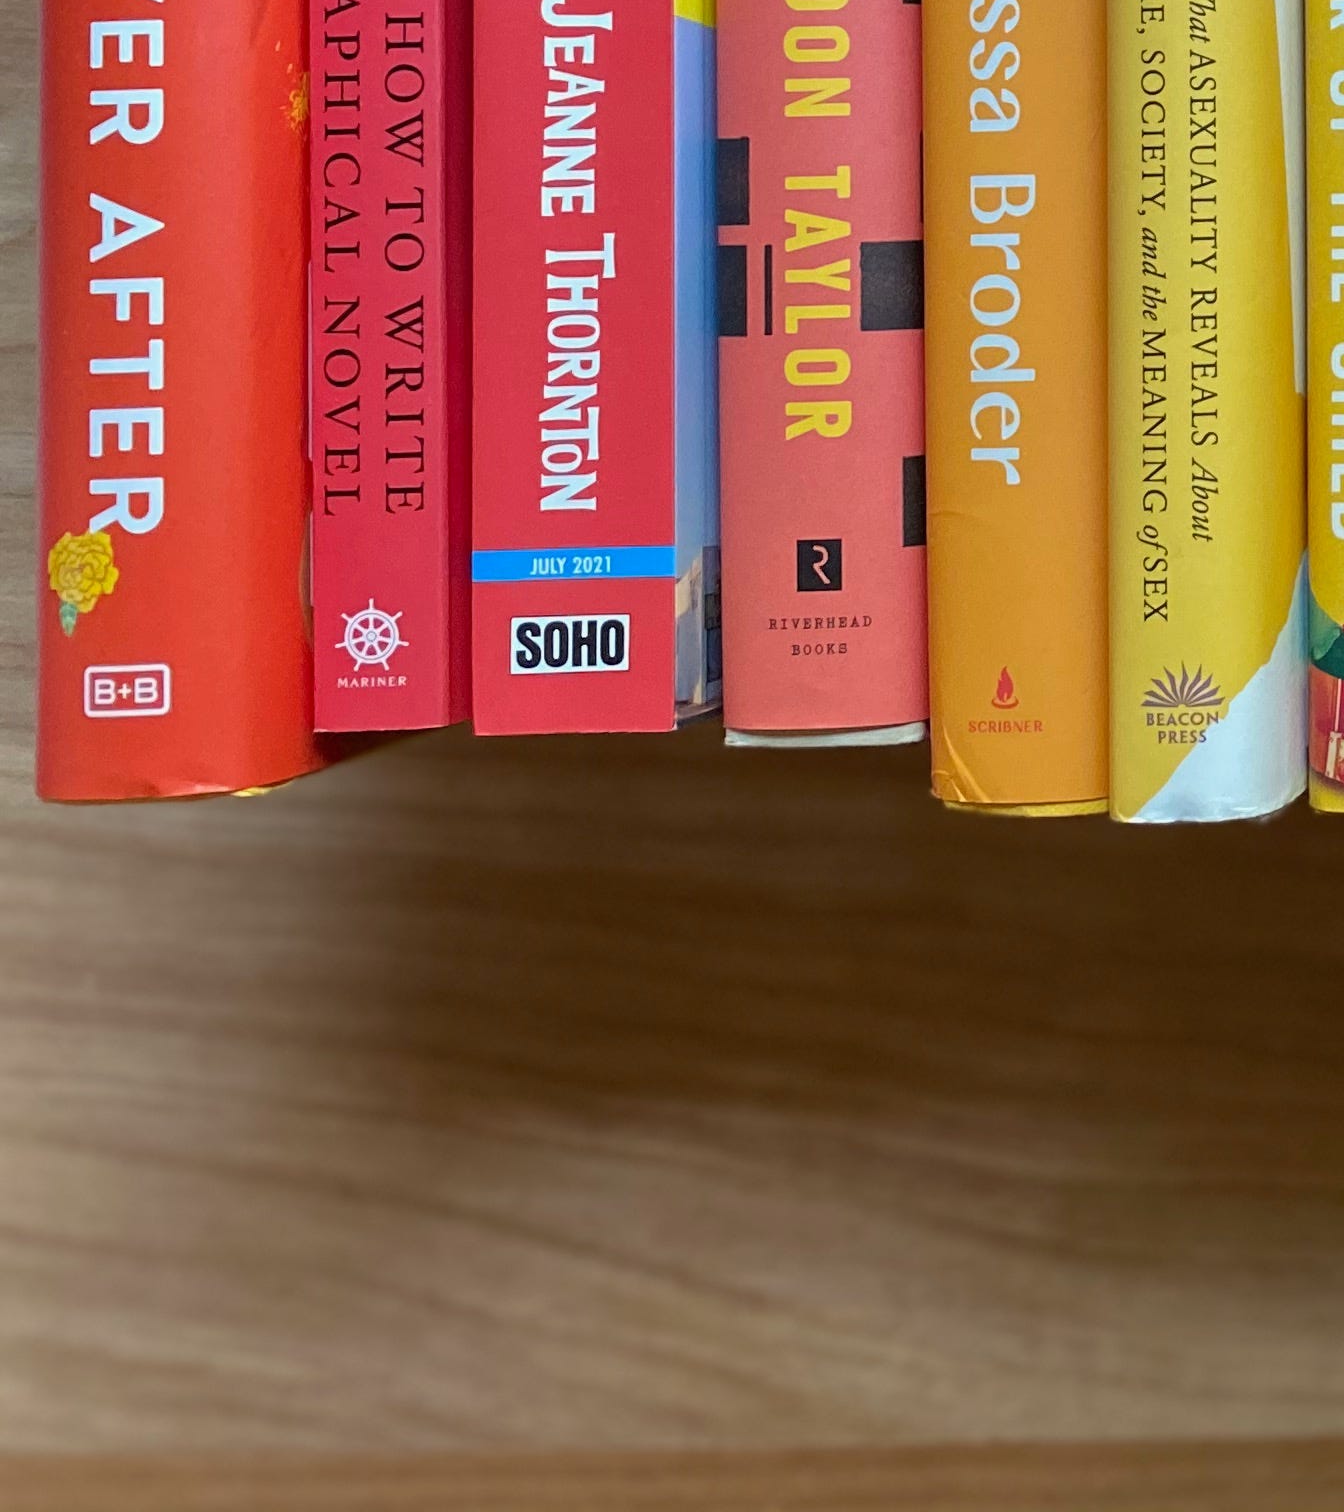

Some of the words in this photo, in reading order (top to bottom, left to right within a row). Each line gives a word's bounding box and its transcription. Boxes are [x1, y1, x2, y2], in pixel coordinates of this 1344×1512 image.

[384, 11, 425, 167] HOW
[1138, 49, 1167, 216] SOCIETY,
[1188, 49, 1219, 274] ASEXUALITY
[384, 187, 425, 272] TO
[1142, 227, 1168, 279] and
[784, 165, 852, 441] TAYLOR
[969, 173, 1036, 486] Broder
[1142, 285, 1168, 322] the
[88, 192, 164, 535] AFTER
[323, 295, 361, 516] NOVEL
[384, 295, 425, 514] WRITE
[538, 232, 616, 511] THORNTON
[1189, 286, 1220, 447] REVEALS
[1141, 329, 1169, 514] MEANING
[1136, 525, 1168, 557] of
[1191, 455, 1220, 542] About
[530, 556, 565, 574] JULY
[573, 556, 611, 573] 2021
[1143, 557, 1169, 623] SEX
[515, 620, 625, 667] SOHO
[769, 614, 872, 632] RIVERHEAD
[791, 640, 848, 656] BOOKS
[337, 676, 407, 688] MARINER
[1145, 711, 1219, 728] BEACON
[968, 719, 1043, 734] SCRIBNER
[1157, 729, 1207, 744] PRESS
